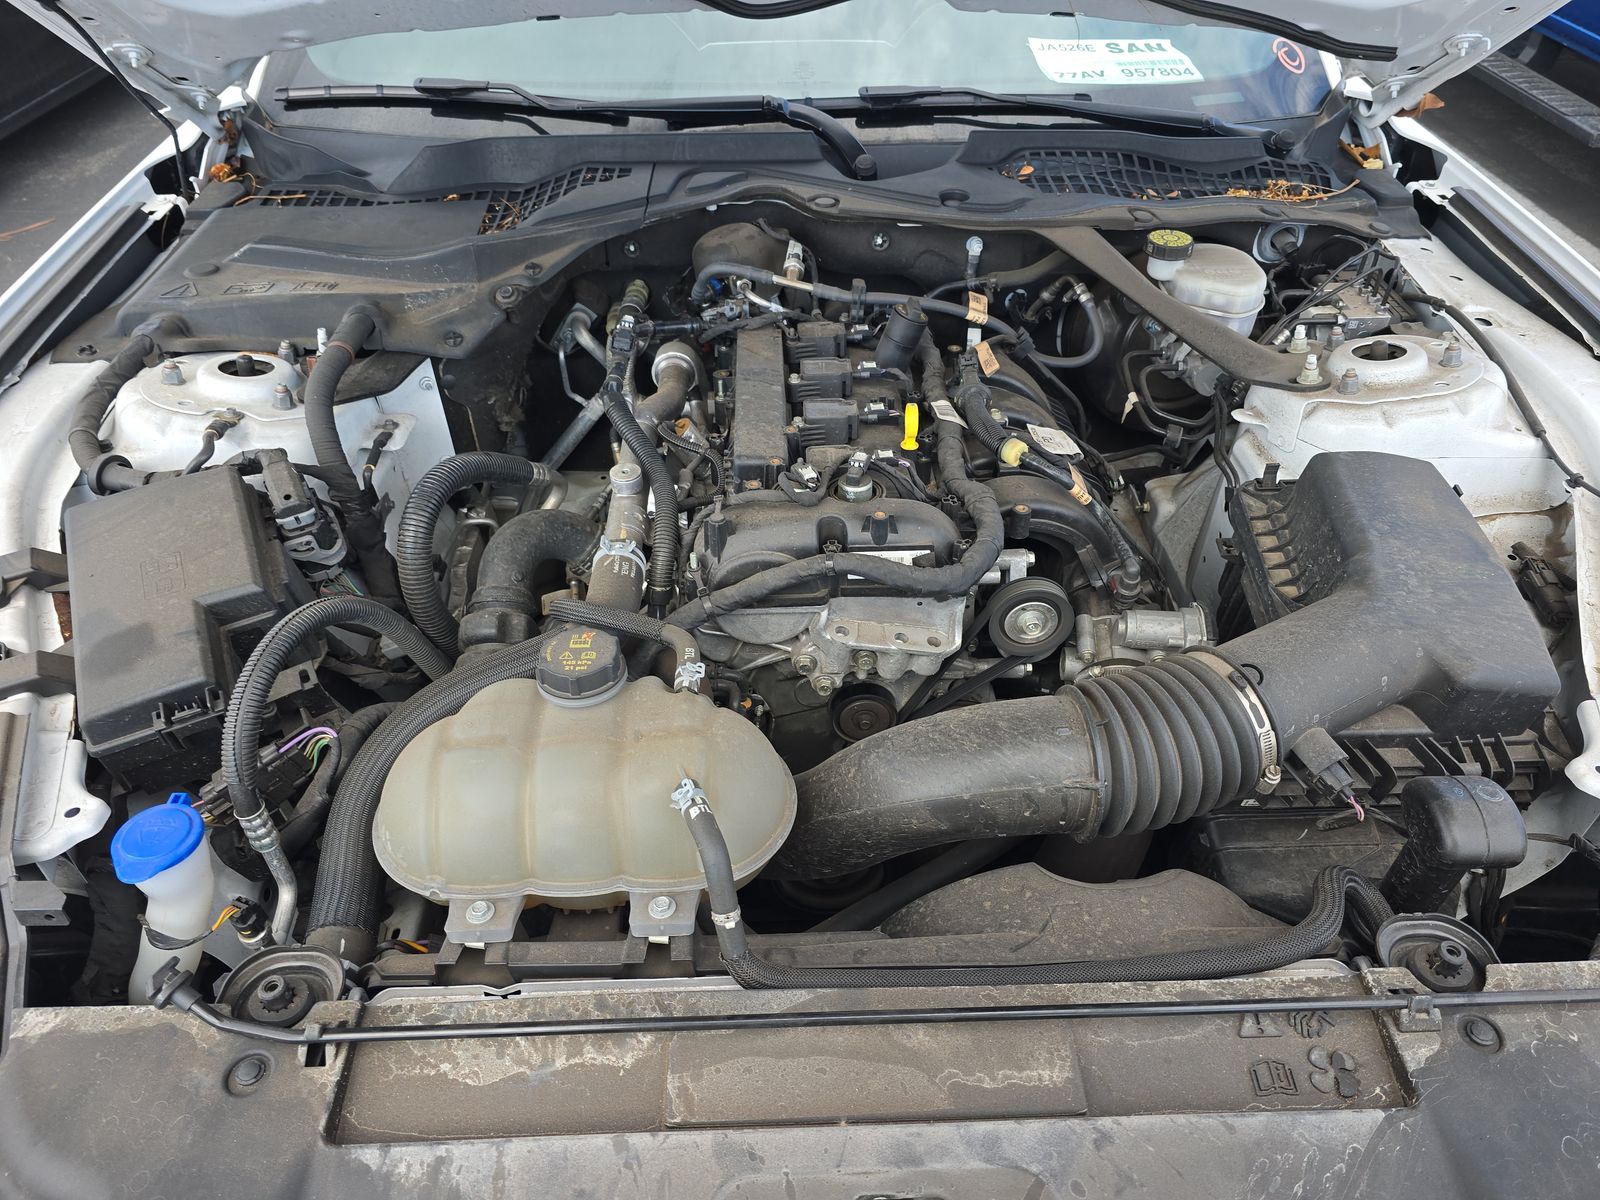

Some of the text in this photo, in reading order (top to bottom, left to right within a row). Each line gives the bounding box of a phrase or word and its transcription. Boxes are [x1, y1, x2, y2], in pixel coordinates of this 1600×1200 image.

[1038, 42, 1168, 54] JA526E SAN
[1121, 66, 1195, 78] 957804
[689, 804, 713, 820] BTL
